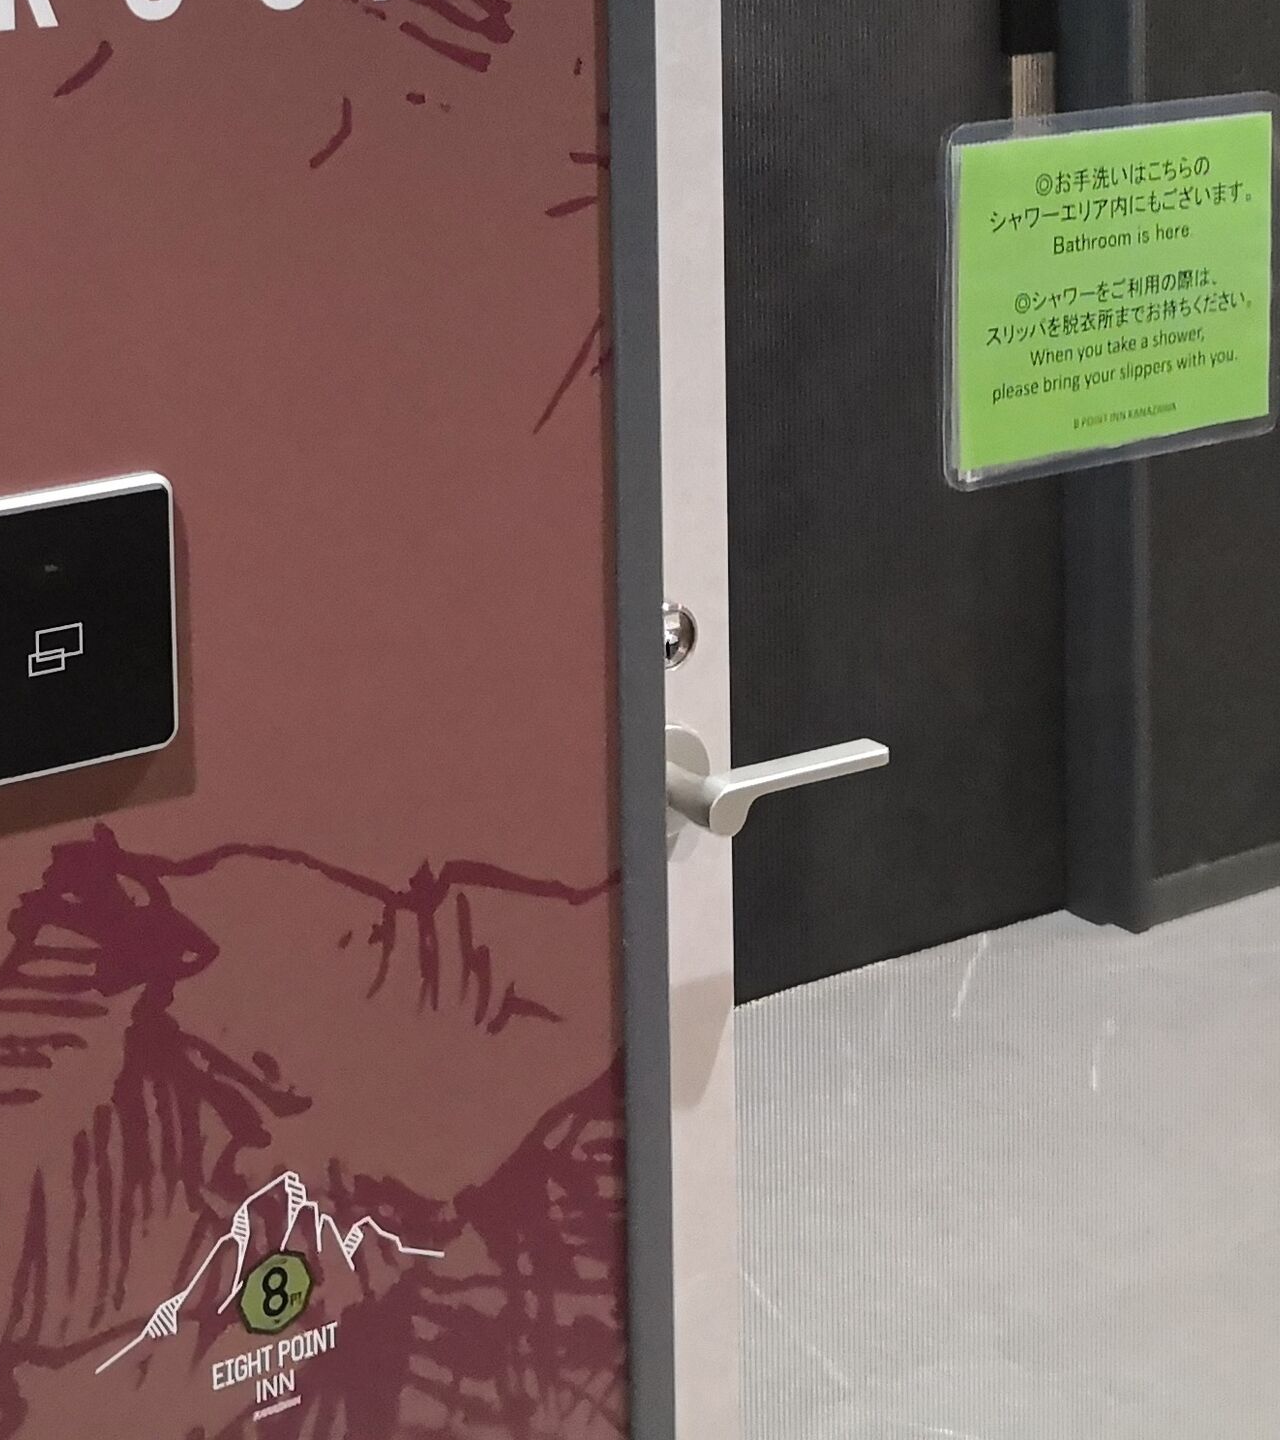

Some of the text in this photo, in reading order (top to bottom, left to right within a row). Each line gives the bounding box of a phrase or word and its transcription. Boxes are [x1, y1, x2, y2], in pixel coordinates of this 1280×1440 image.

[1053, 223, 1190, 255] Bathroom is here
[1030, 326, 1205, 367] When you take a shower,
[992, 349, 1239, 406] please bring your slippers with you.
[261, 1266, 290, 1318] 8
[212, 1321, 339, 1392] EIGHT POINT
[255, 1368, 297, 1405] INN
